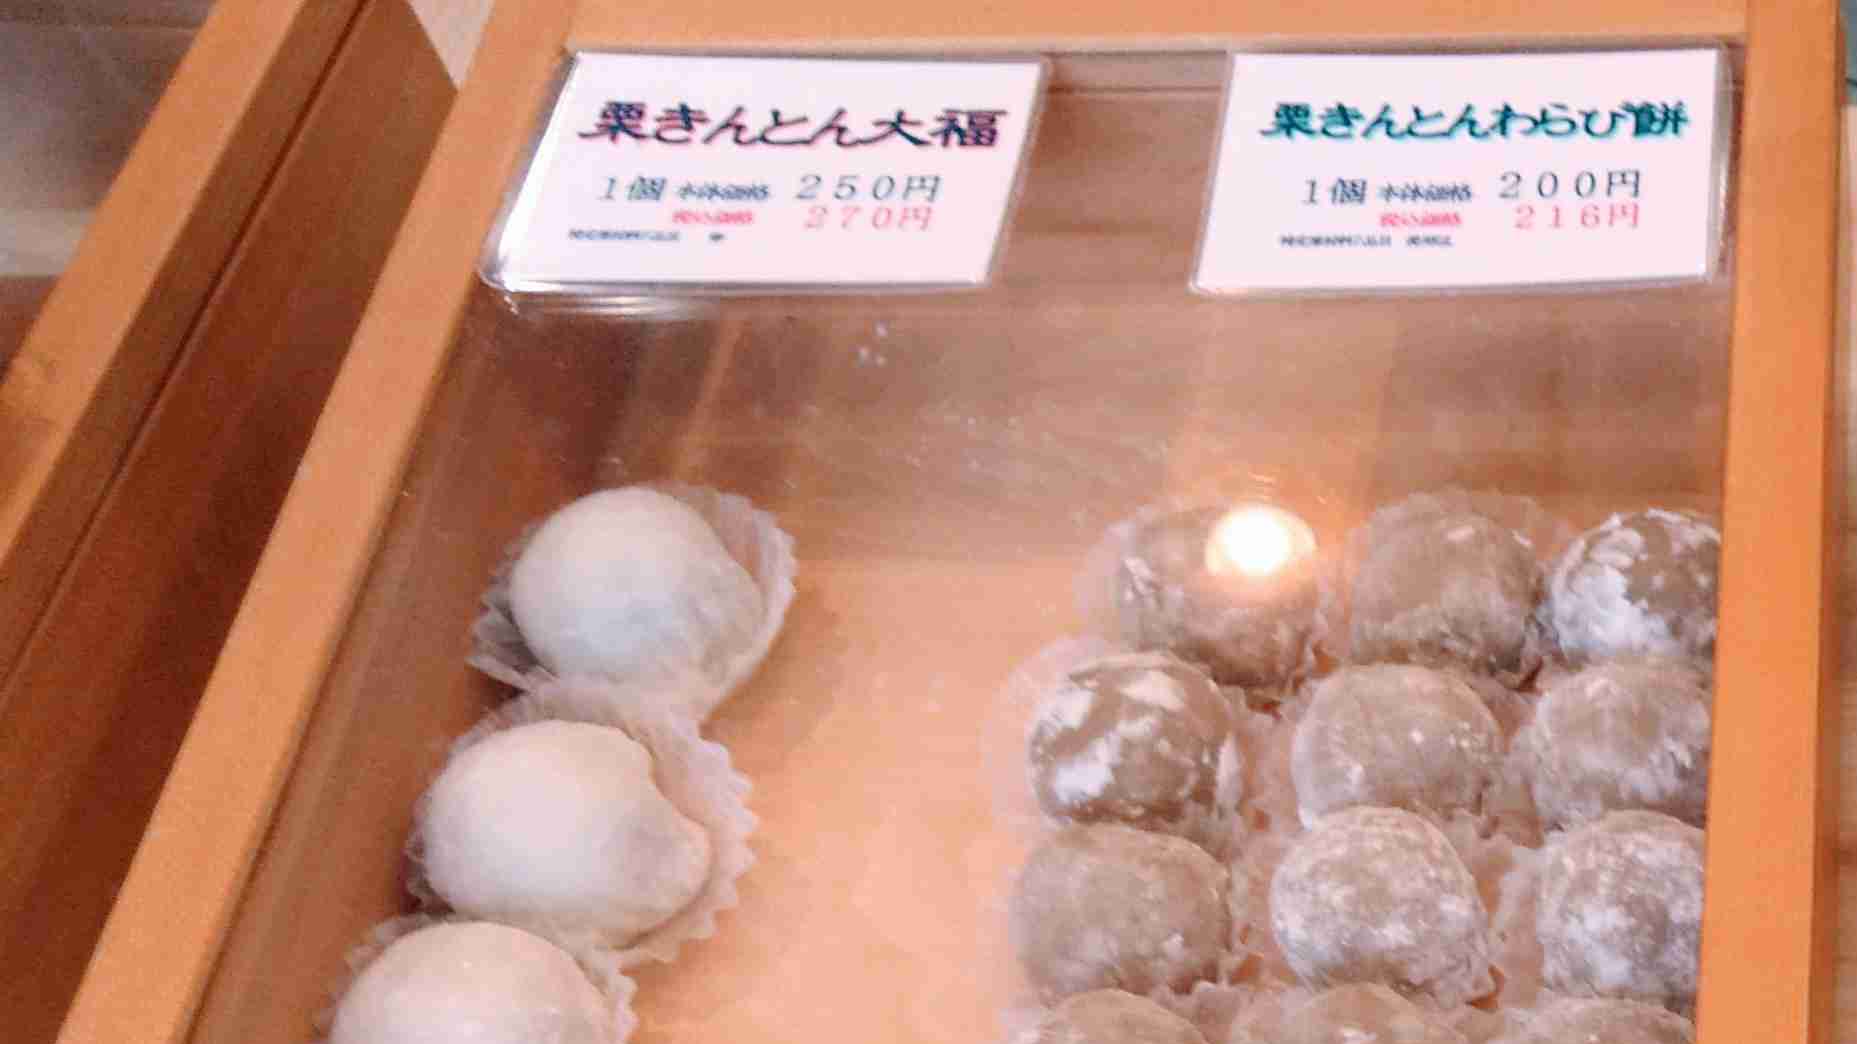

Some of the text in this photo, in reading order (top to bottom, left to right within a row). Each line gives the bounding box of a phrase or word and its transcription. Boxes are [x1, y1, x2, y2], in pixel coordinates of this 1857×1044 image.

[578, 101, 1008, 149] 栗きんとん大福
[1499, 169, 1641, 199] 200円
[1515, 202, 1640, 230] 216円
